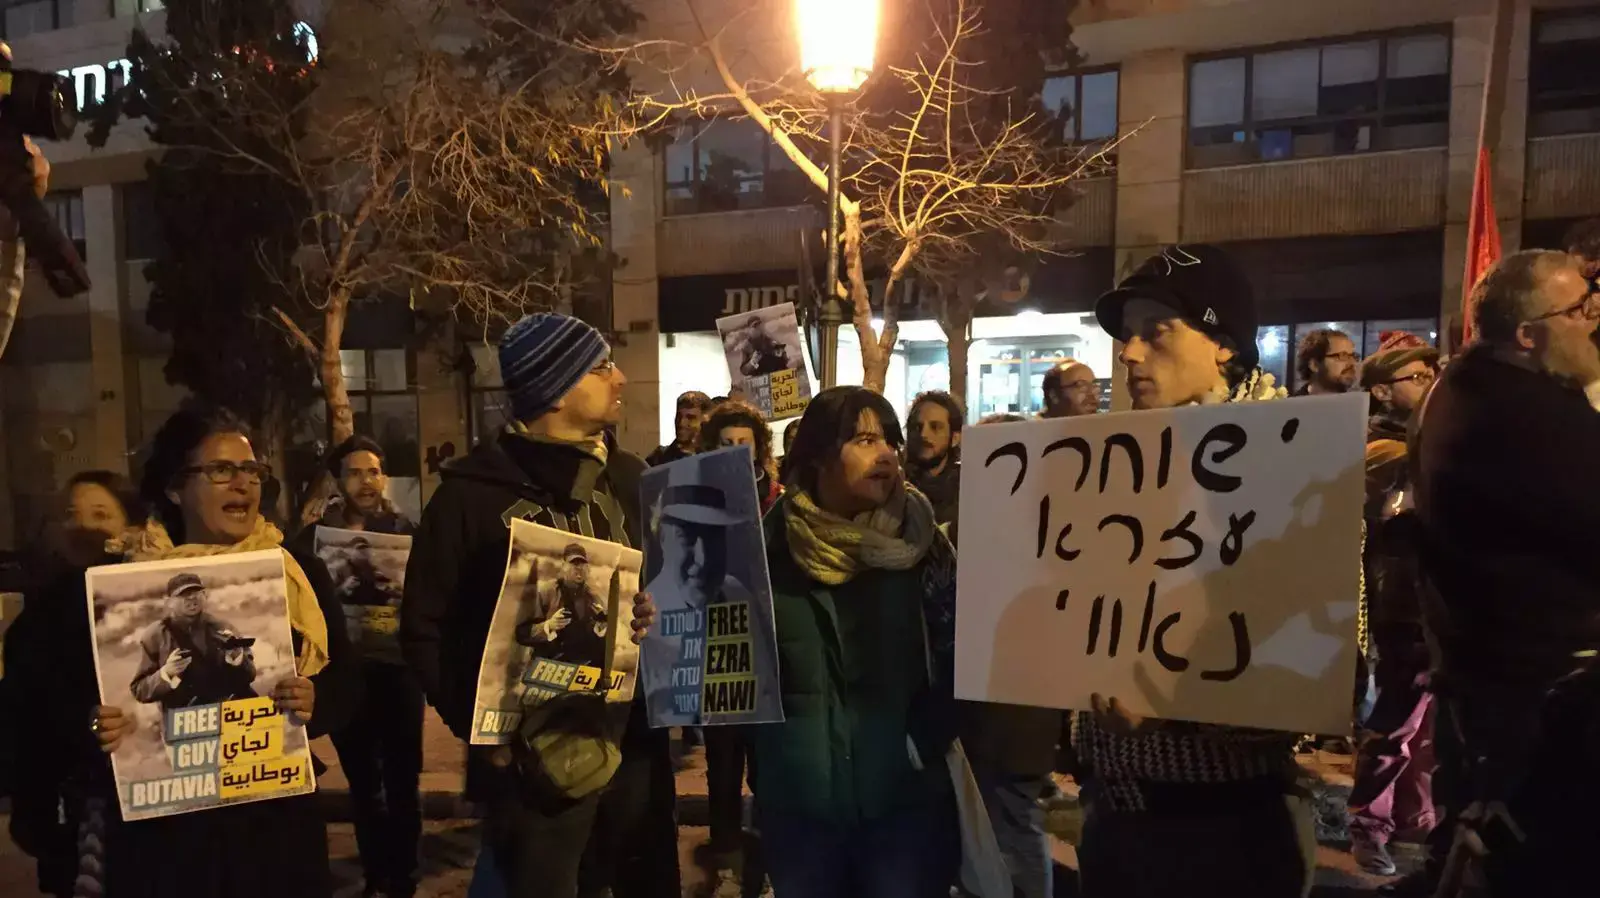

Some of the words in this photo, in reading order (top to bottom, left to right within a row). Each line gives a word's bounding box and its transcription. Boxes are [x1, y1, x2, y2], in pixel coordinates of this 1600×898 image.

[985, 418, 1299, 495] ישוחרר
[1037, 495, 1256, 569] עזרא
[708, 603, 749, 637] FREE
[1056, 579, 1251, 681] נאווי
[684, 637, 702, 659] את
[706, 642, 751, 675] EZRA
[531, 661, 577, 685] FREE
[672, 665, 700, 687] עזרא
[704, 680, 756, 712] NAWI
[173, 707, 218, 736] FREE
[178, 740, 218, 768] GUY
[132, 773, 217, 806] BUTAVIA
[222, 763, 300, 790] بوطابية
